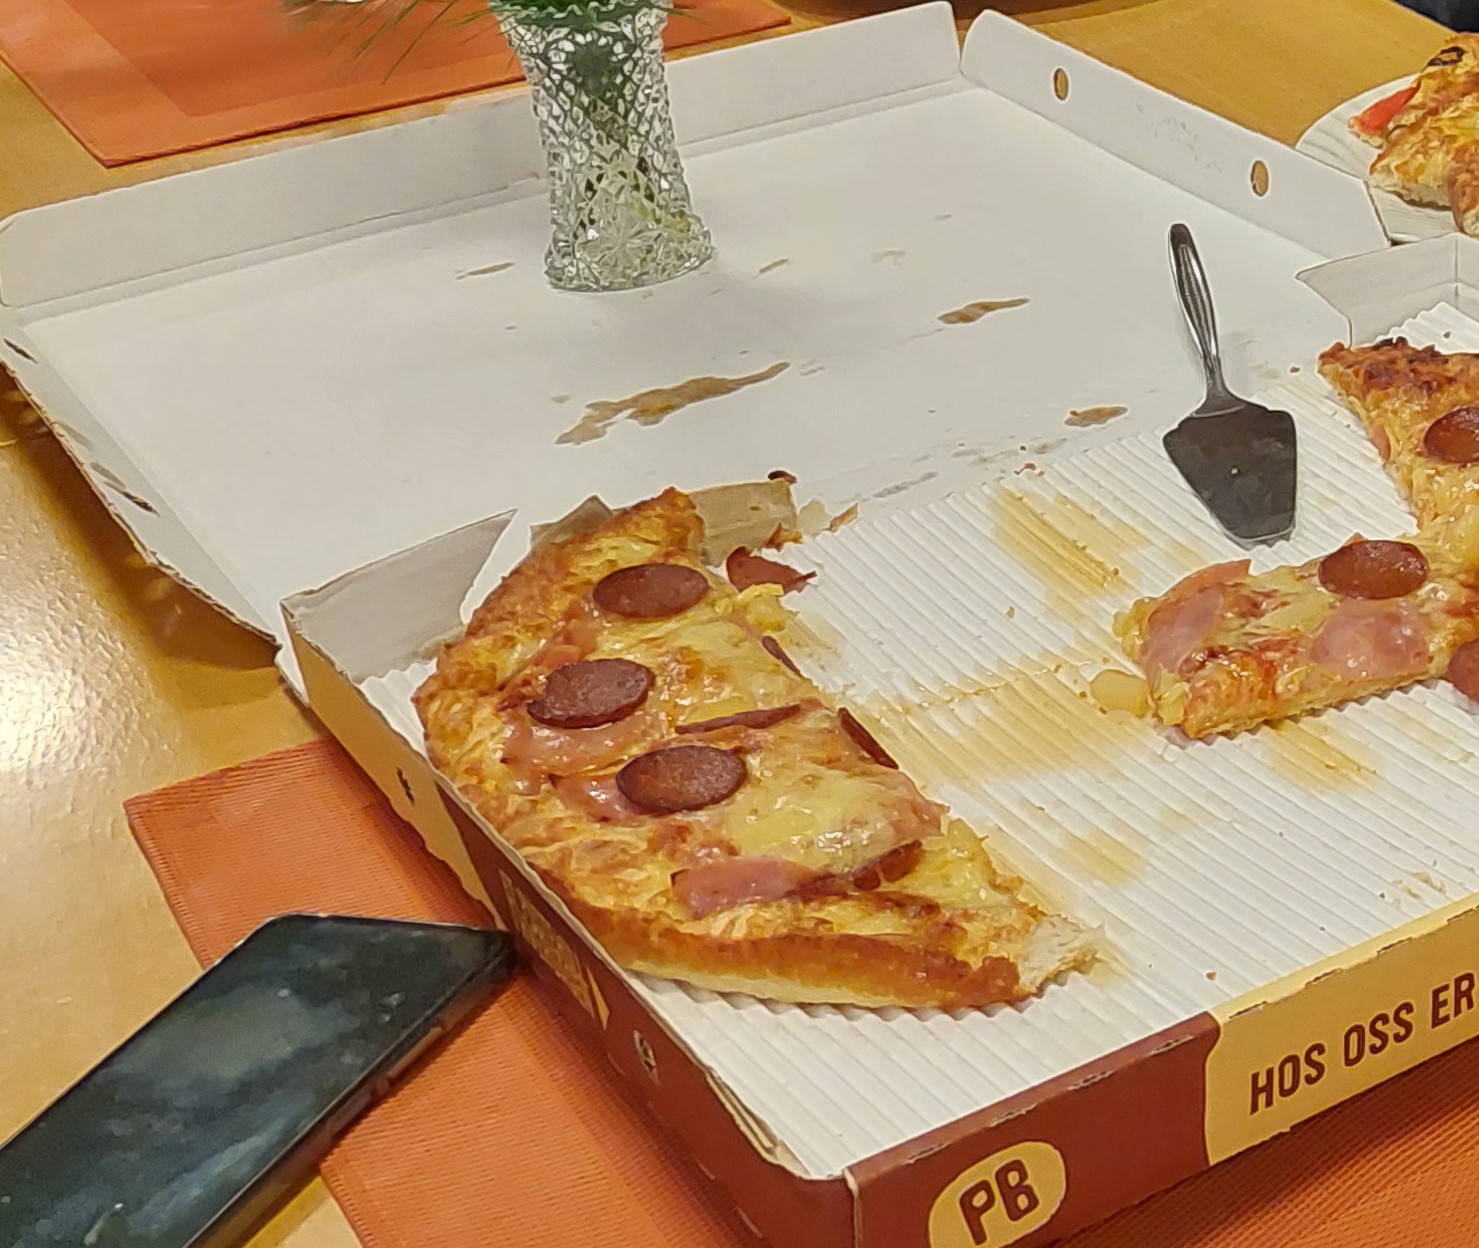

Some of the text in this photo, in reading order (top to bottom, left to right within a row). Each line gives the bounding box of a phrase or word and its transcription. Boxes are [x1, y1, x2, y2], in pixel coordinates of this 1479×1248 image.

[1249, 1042, 1327, 1116] HOS
[1343, 1001, 1415, 1067] OSS
[1430, 972, 1476, 1030] ER
[958, 1159, 1040, 1247] PB
